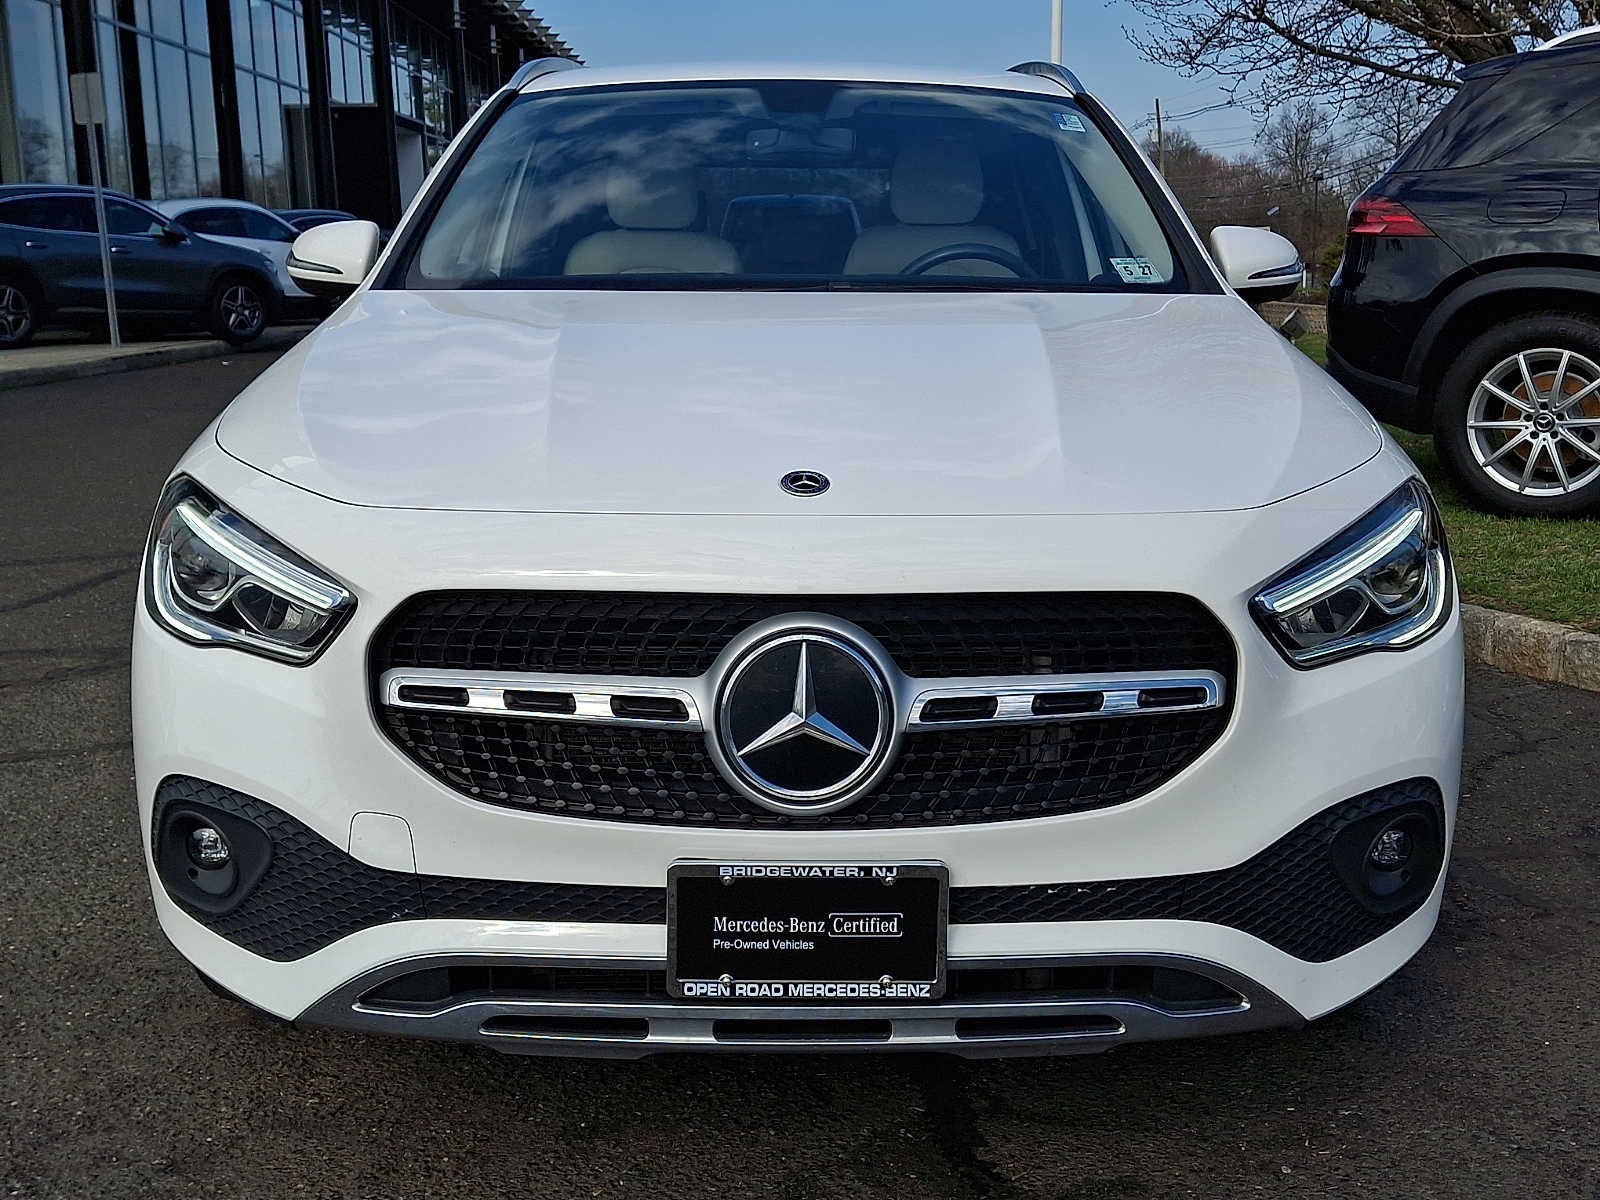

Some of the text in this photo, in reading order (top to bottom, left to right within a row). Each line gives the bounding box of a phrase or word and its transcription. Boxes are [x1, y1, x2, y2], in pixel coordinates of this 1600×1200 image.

[1123, 265, 1153, 276] 5 27
[719, 866, 897, 877] BRIDGEWATER, NJ
[713, 917, 898, 933] Mercedes-Benz Certified
[713, 939, 814, 950] Pre-Owned Vehicles
[683, 984, 730, 997] OPEN
[735, 984, 783, 997] ROAD
